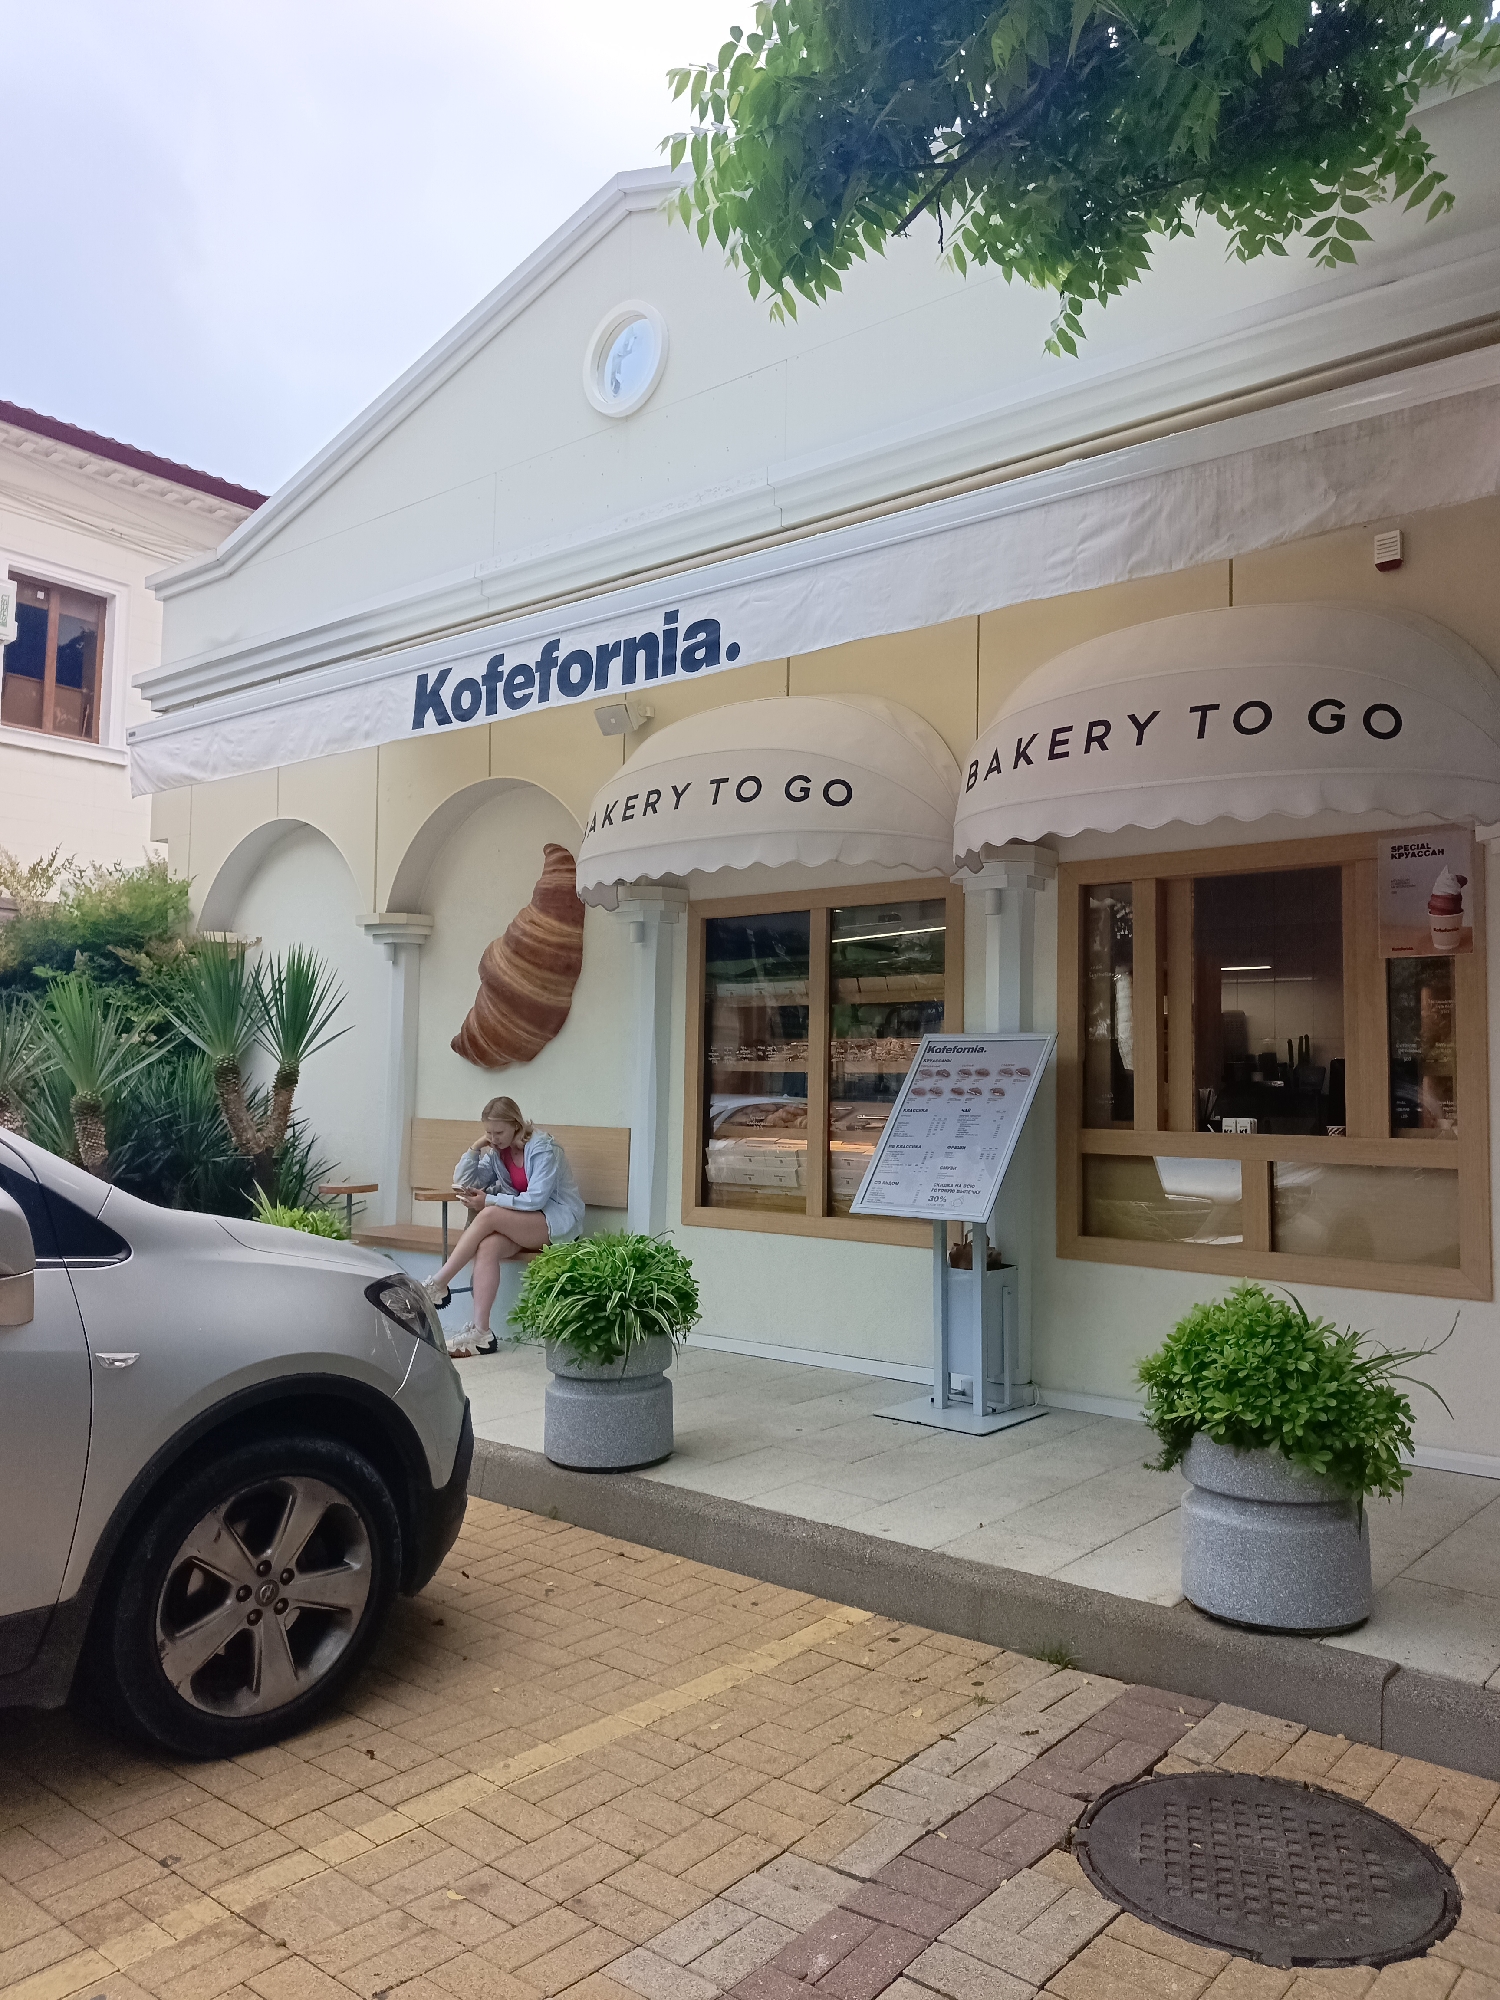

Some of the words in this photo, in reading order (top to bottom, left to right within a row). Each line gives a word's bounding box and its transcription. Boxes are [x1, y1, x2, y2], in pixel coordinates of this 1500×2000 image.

[411, 608, 741, 730] Kofefornia.
[965, 710, 1161, 794] BAKERY
[1189, 700, 1273, 740] TO
[1307, 698, 1403, 740] GO
[709, 775, 762, 806] TO
[784, 774, 853, 807] GO
[1390, 842, 1432, 853] SPECIAL
[1390, 848, 1445, 860] КРУАССАН
[926, 1045, 987, 1054] Kofefornia.
[927, 1195, 947, 1203] 30%
